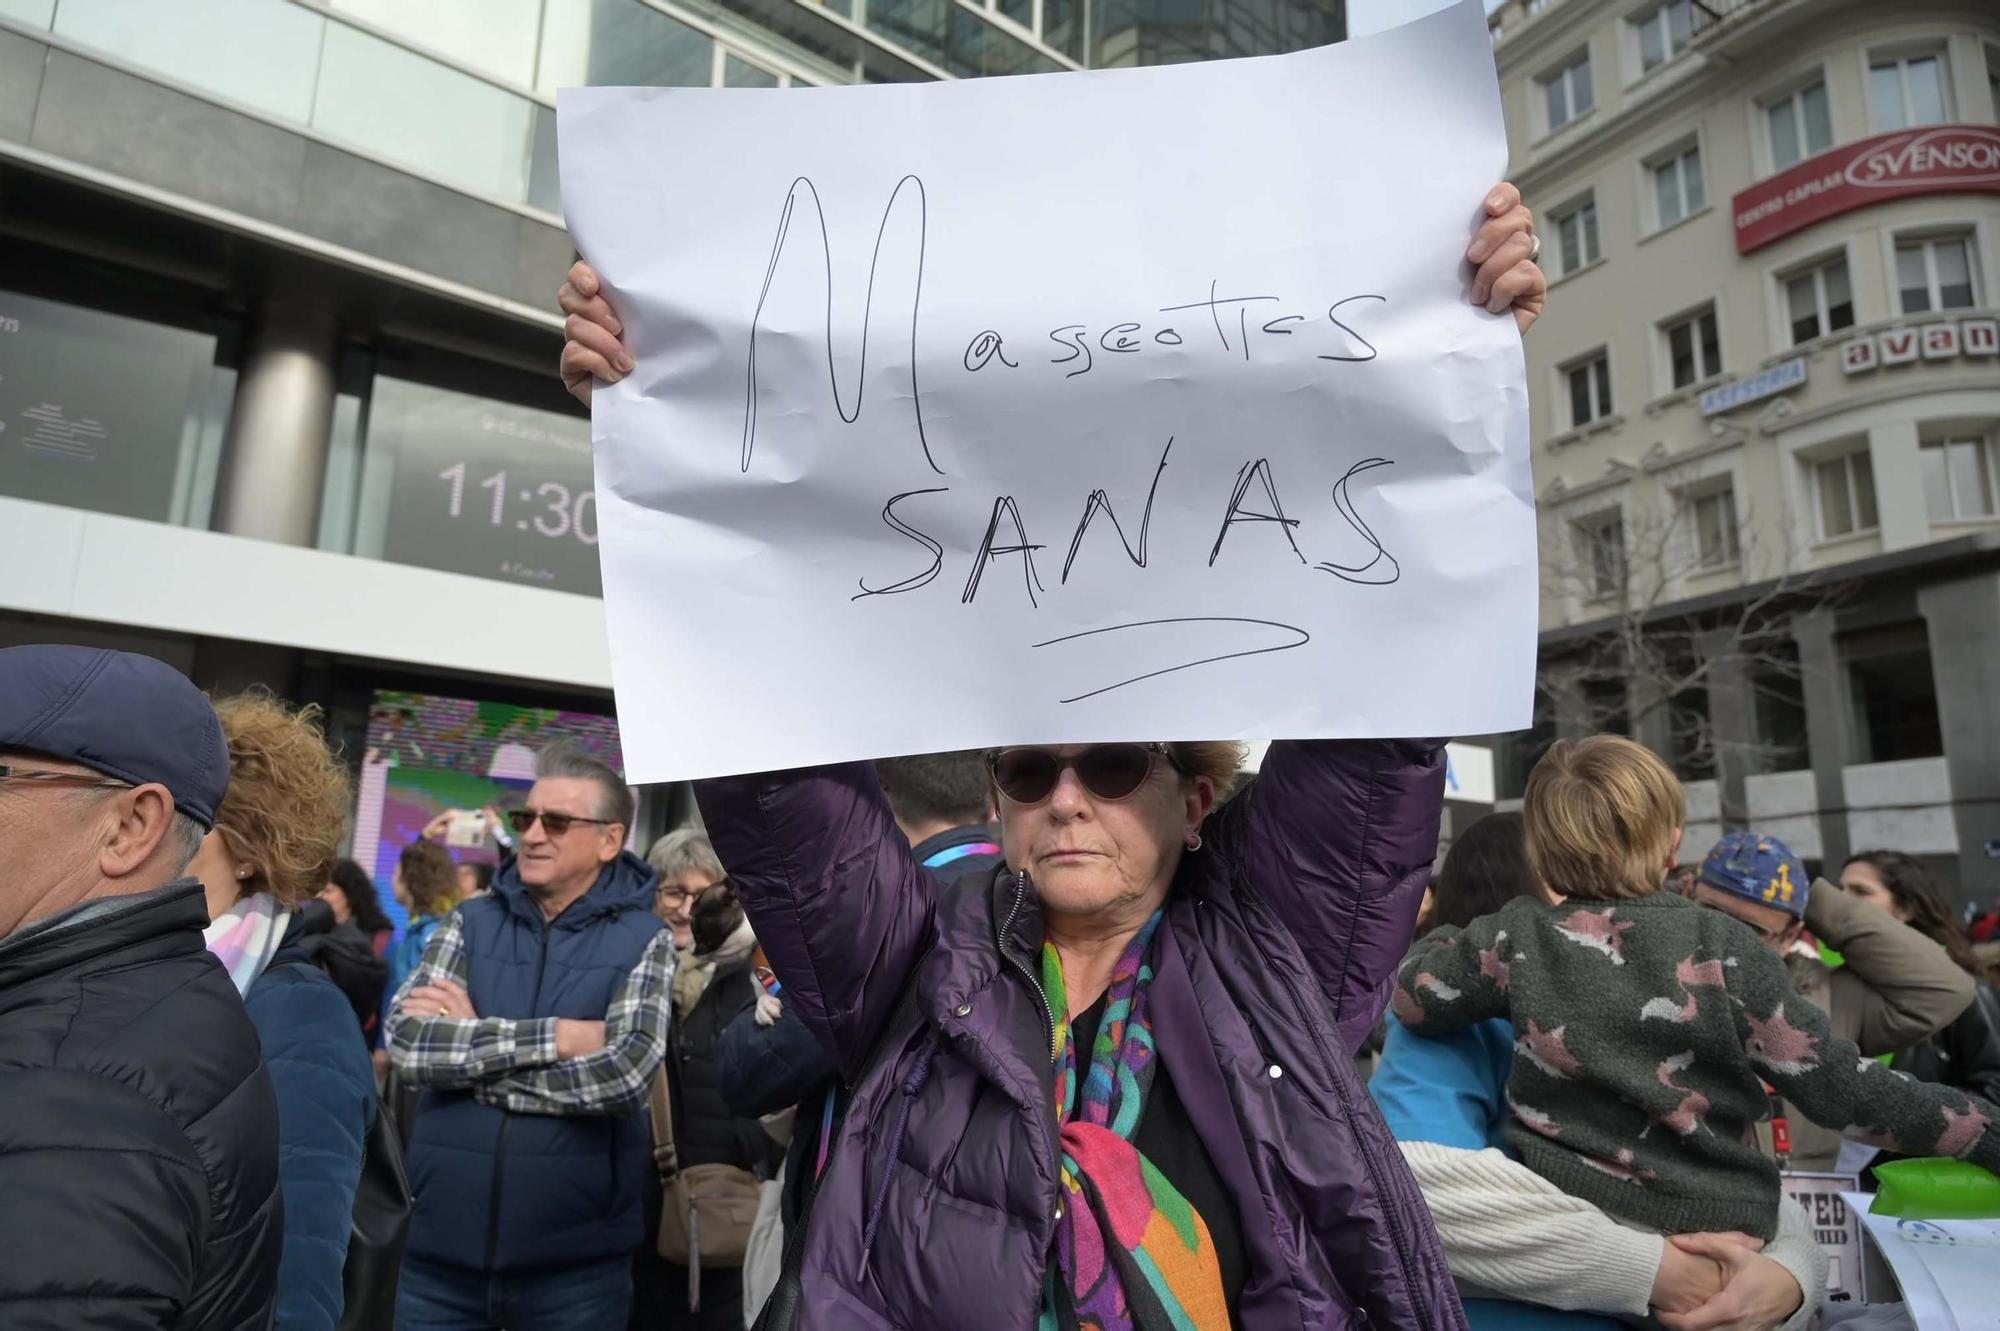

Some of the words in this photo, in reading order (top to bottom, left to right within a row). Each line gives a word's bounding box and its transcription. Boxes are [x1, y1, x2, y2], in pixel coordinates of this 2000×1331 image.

[1737, 196, 1784, 229] CENTRO
[1785, 171, 1844, 206] CAPILAR
[851, 435, 1400, 608] SANAS
[1790, 1192, 1846, 1227] TED
